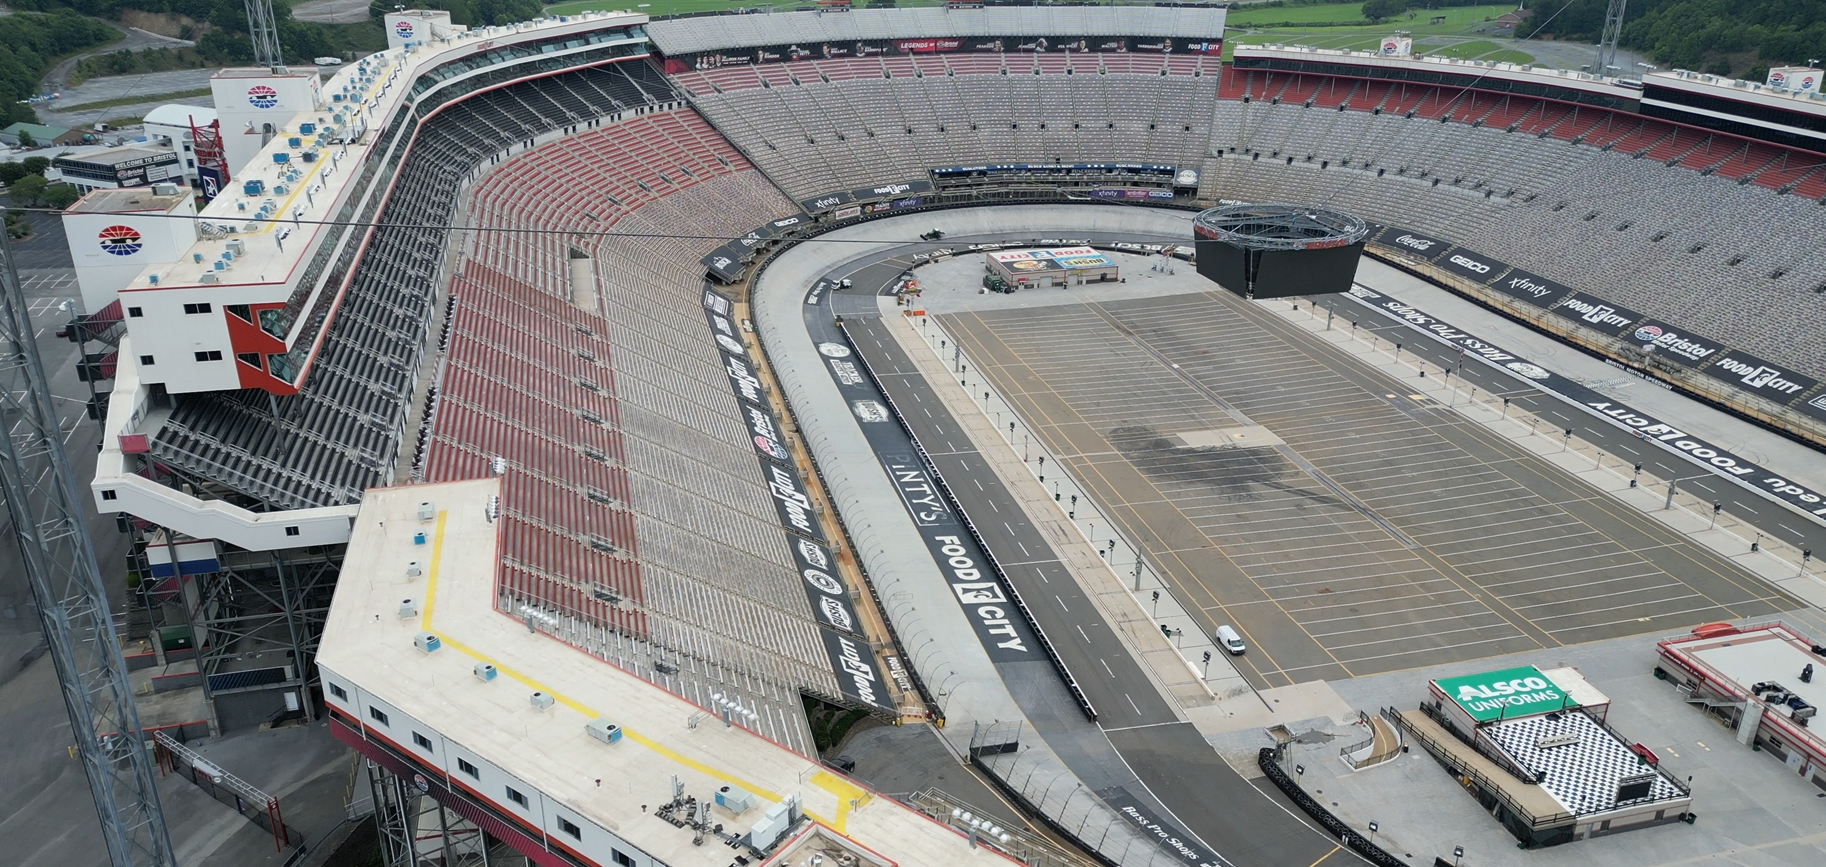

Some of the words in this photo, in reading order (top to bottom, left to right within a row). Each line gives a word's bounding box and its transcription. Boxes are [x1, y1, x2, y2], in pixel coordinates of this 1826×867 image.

[114, 159, 143, 168] WELCOME
[154, 153, 176, 162] BRISTOL
[815, 196, 840, 209] xfinity
[900, 199, 916, 208] xfinity
[1450, 255, 1490, 274] GEICO
[1508, 277, 1552, 298] xfinity
[1383, 300, 1436, 325] Shops
[1563, 298, 1594, 314] FOOD
[1602, 314, 1632, 328] CITY
[1430, 322, 1468, 340] Pro
[1460, 338, 1516, 361] Bass
[1650, 339, 1670, 349] Motor
[1670, 346, 1700, 360] Speedway
[1658, 332, 1715, 358] Bristol
[1605, 358, 1625, 370] BRISTOL
[1626, 367, 1645, 378] MOTOR
[1645, 375, 1673, 390] SPEEDWAY
[1716, 358, 1754, 376] FOOD
[1767, 378, 1803, 394] CITY
[738, 379, 759, 402] FOOD
[746, 405, 772, 440] Bristol
[1586, 402, 1649, 427] CITY
[1674, 439, 1755, 476] FOOD
[771, 465, 796, 496] CITY
[886, 454, 948, 521] PINTY'S
[784, 501, 812, 533] FOOD
[935, 536, 981, 581] FOOD
[978, 606, 1028, 652] CITY
[838, 636, 860, 662] CITY
[887, 657, 901, 670] FOOD
[898, 678, 911, 694] CITY
[853, 675, 879, 707] FOOD
[1458, 677, 1548, 701] ALSCO
[1468, 690, 1560, 712] UNIFORMS
[1122, 806, 1150, 826] Bass
[1147, 824, 1168, 838] Pro
[1166, 837, 1200, 860] Shops
